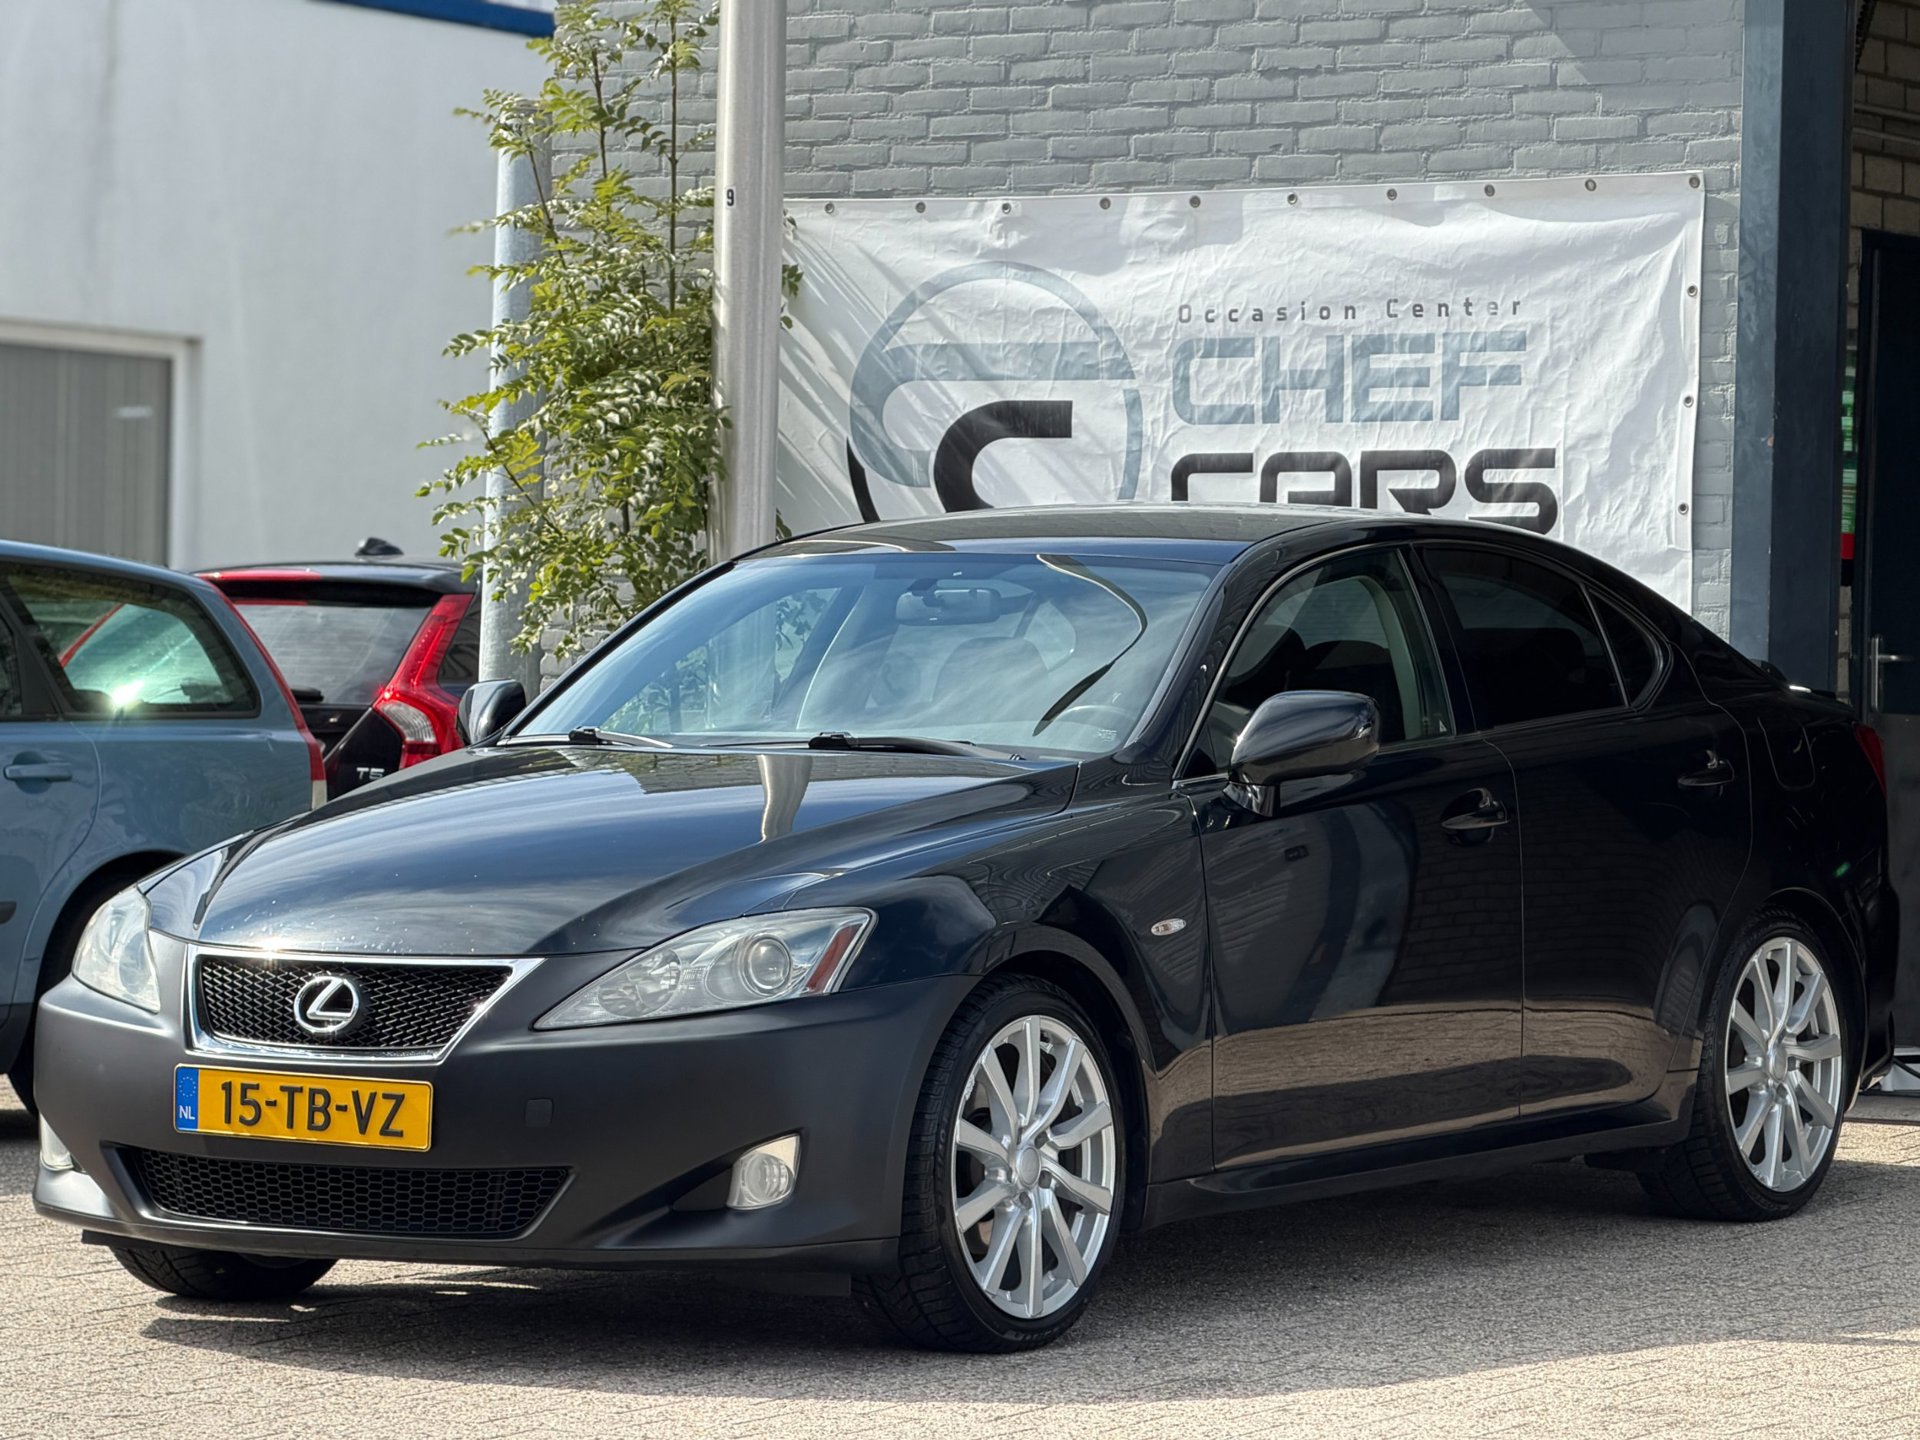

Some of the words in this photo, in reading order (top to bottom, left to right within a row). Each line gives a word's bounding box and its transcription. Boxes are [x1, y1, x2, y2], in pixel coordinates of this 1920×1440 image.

[726, 188, 735, 207] 9
[1178, 301, 1356, 323] Occasion
[1386, 297, 1521, 318] Center
[1172, 331, 1527, 425] CHEF
[356, 766, 385, 780] T5
[179, 1105, 196, 1121] NL
[221, 1080, 405, 1138] 15-TB-VZ
